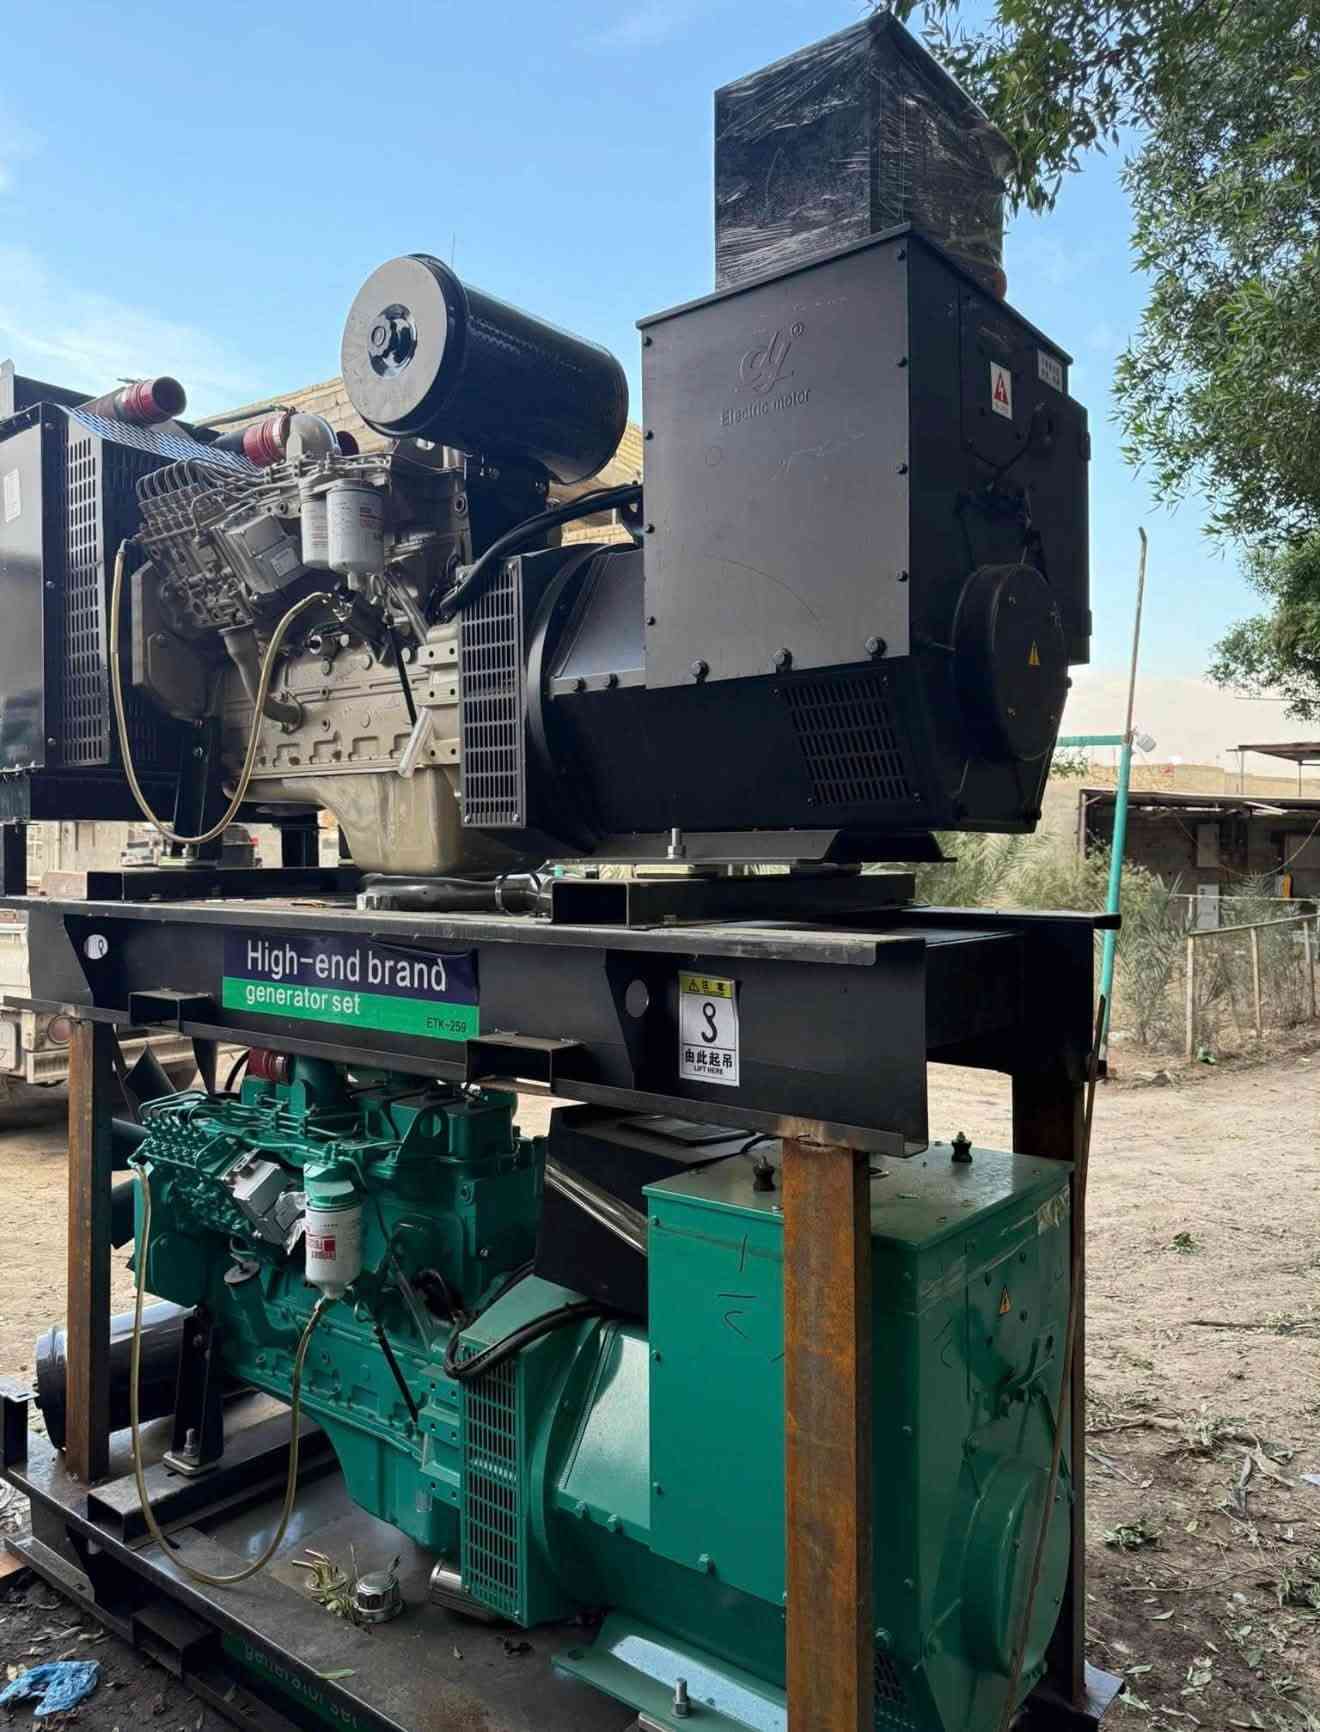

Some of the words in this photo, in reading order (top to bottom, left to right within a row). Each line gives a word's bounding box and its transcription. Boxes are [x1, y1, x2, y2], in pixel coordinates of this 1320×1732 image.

[774, 389, 811, 409] motor
[247, 940, 360, 983] High-end
[367, 951, 447, 992] brand
[246, 985, 328, 1010] generator
[332, 994, 361, 1015] set
[426, 1017, 466, 1033] ETK-259
[685, 1048, 733, 1069] 由此起吊
